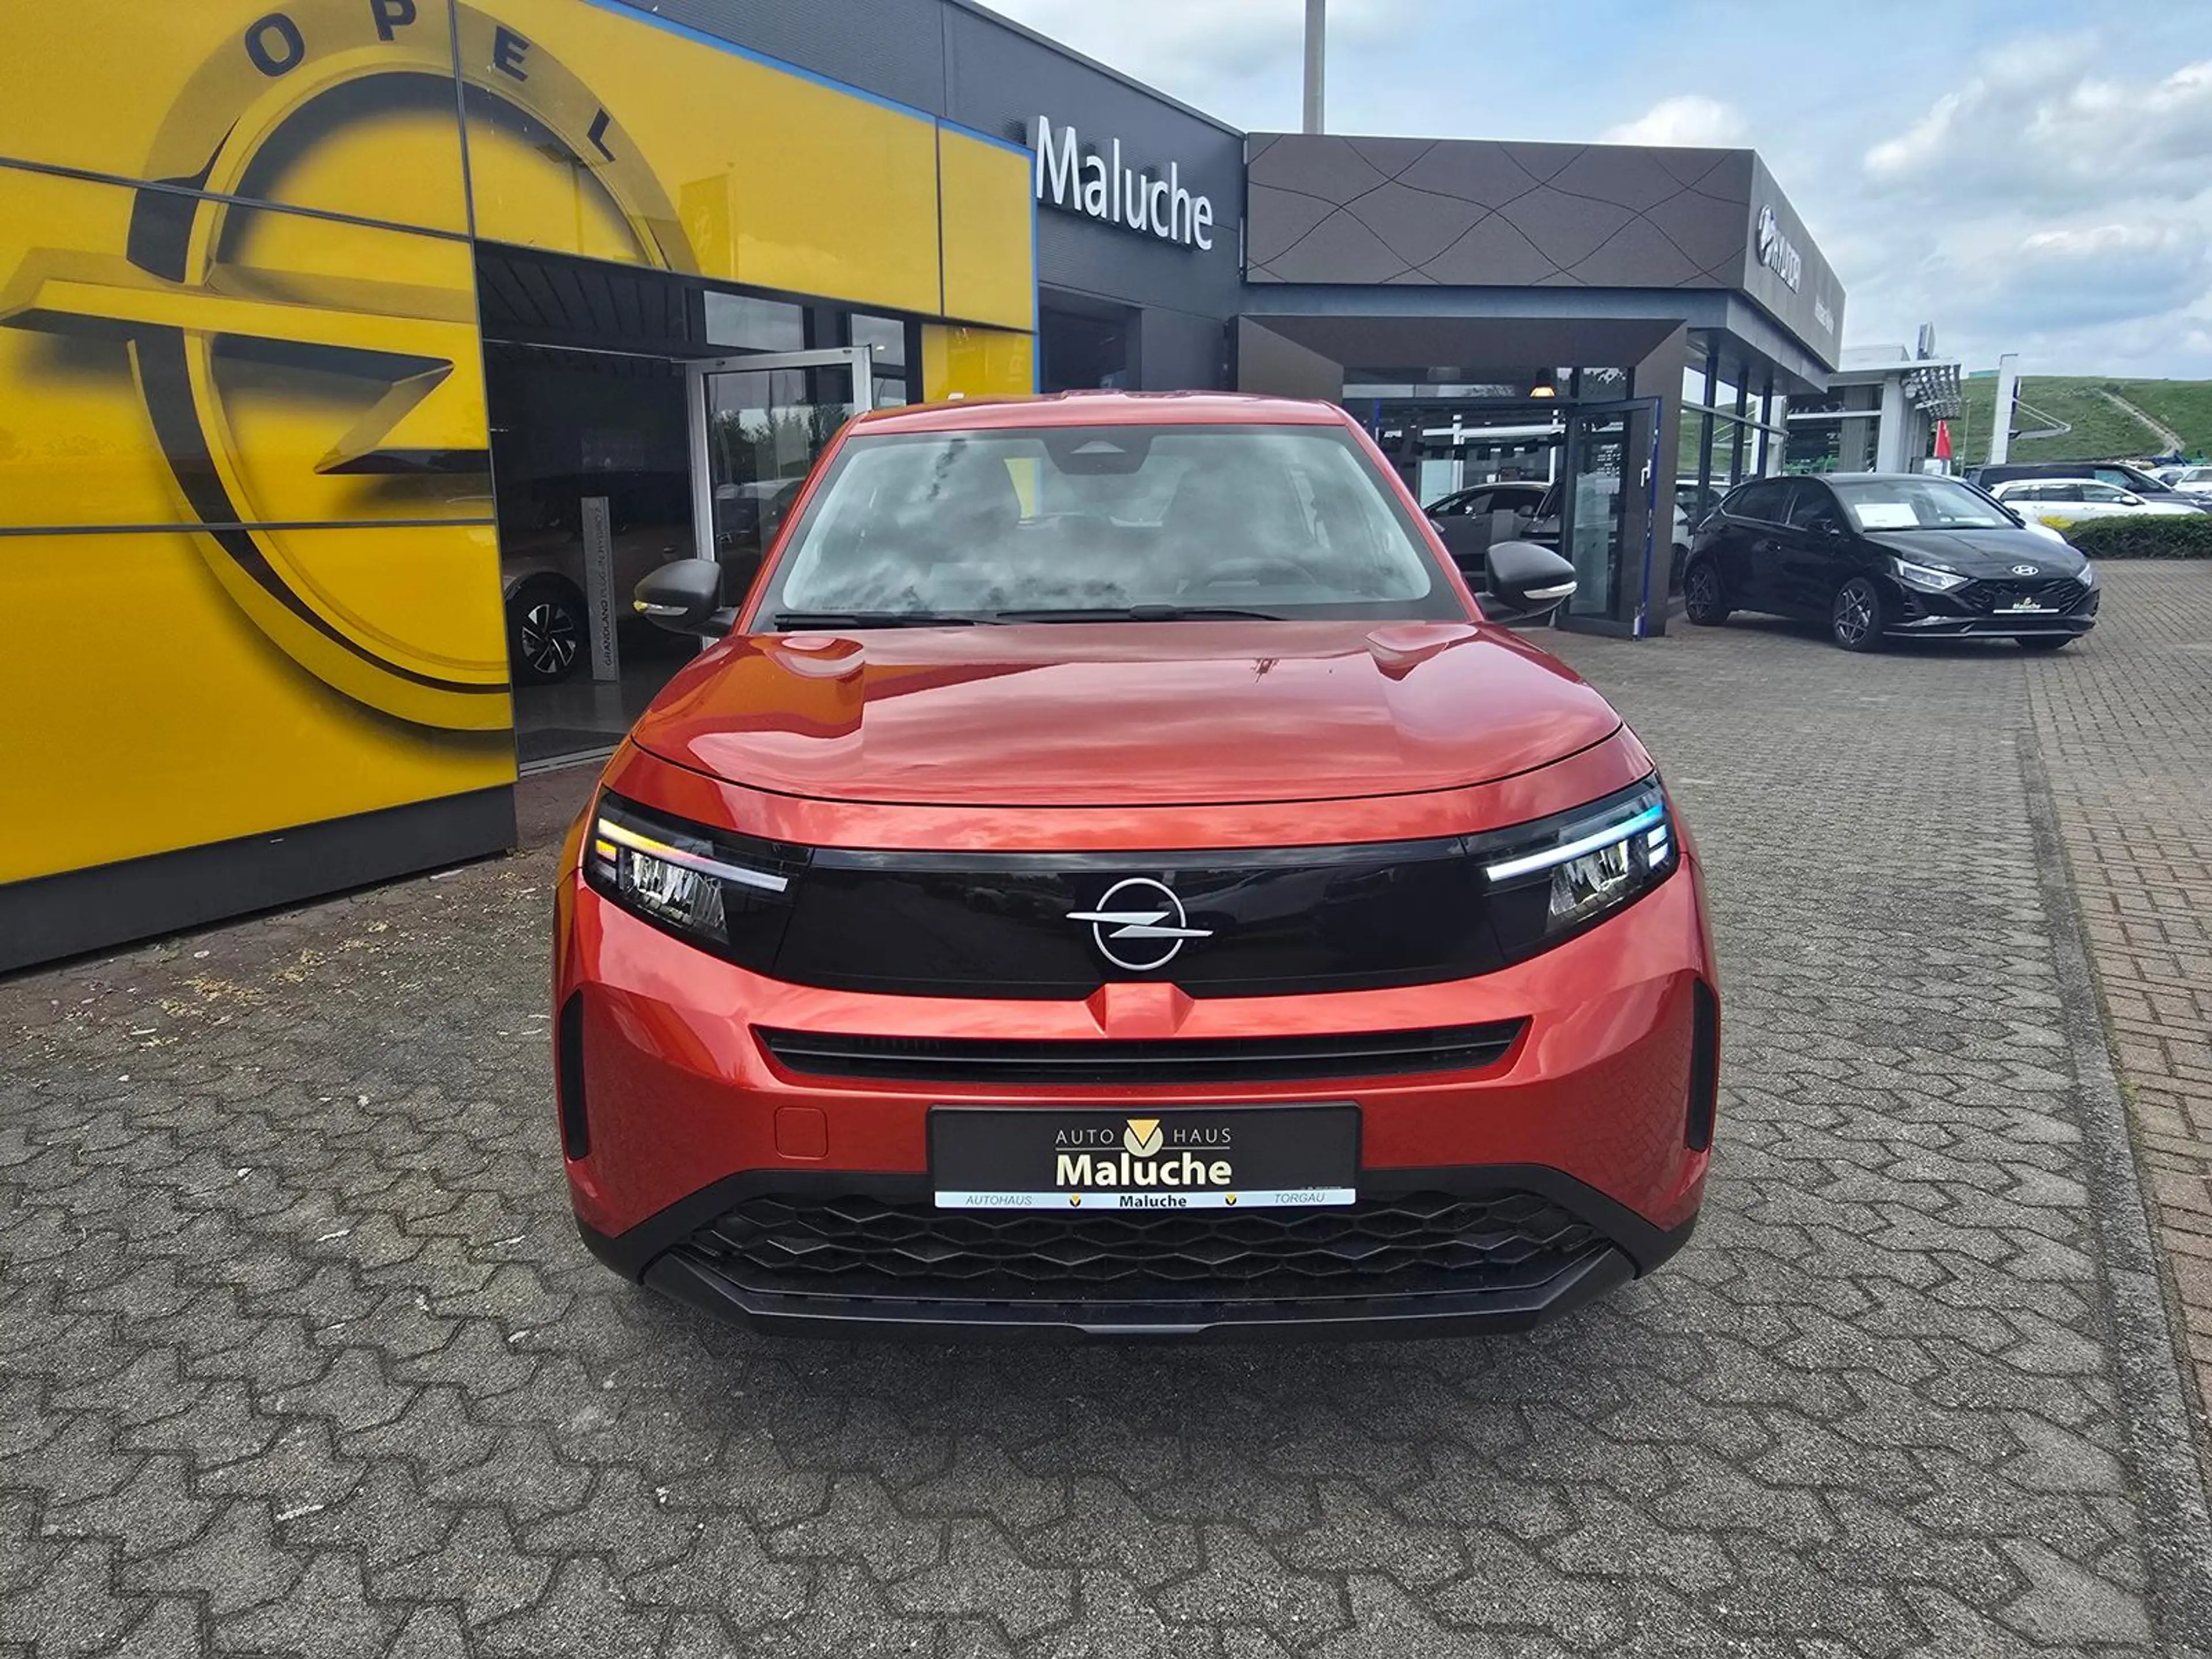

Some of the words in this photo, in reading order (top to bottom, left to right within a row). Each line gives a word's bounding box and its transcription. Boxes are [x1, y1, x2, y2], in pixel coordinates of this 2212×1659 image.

[244, 0, 615, 162] OPEL
[1037, 115, 1213, 250] Maluche
[600, 600, 612, 666] GRANDLAND
[1055, 1129, 1114, 1144] AUTO
[1173, 1128, 1232, 1143] HAUS
[1056, 1152, 1232, 1186] Maluche
[965, 1195, 1032, 1205] AUTOHAUS
[1119, 1195, 1187, 1207] Maluche
[1274, 1193, 1325, 1203] TORGAU
